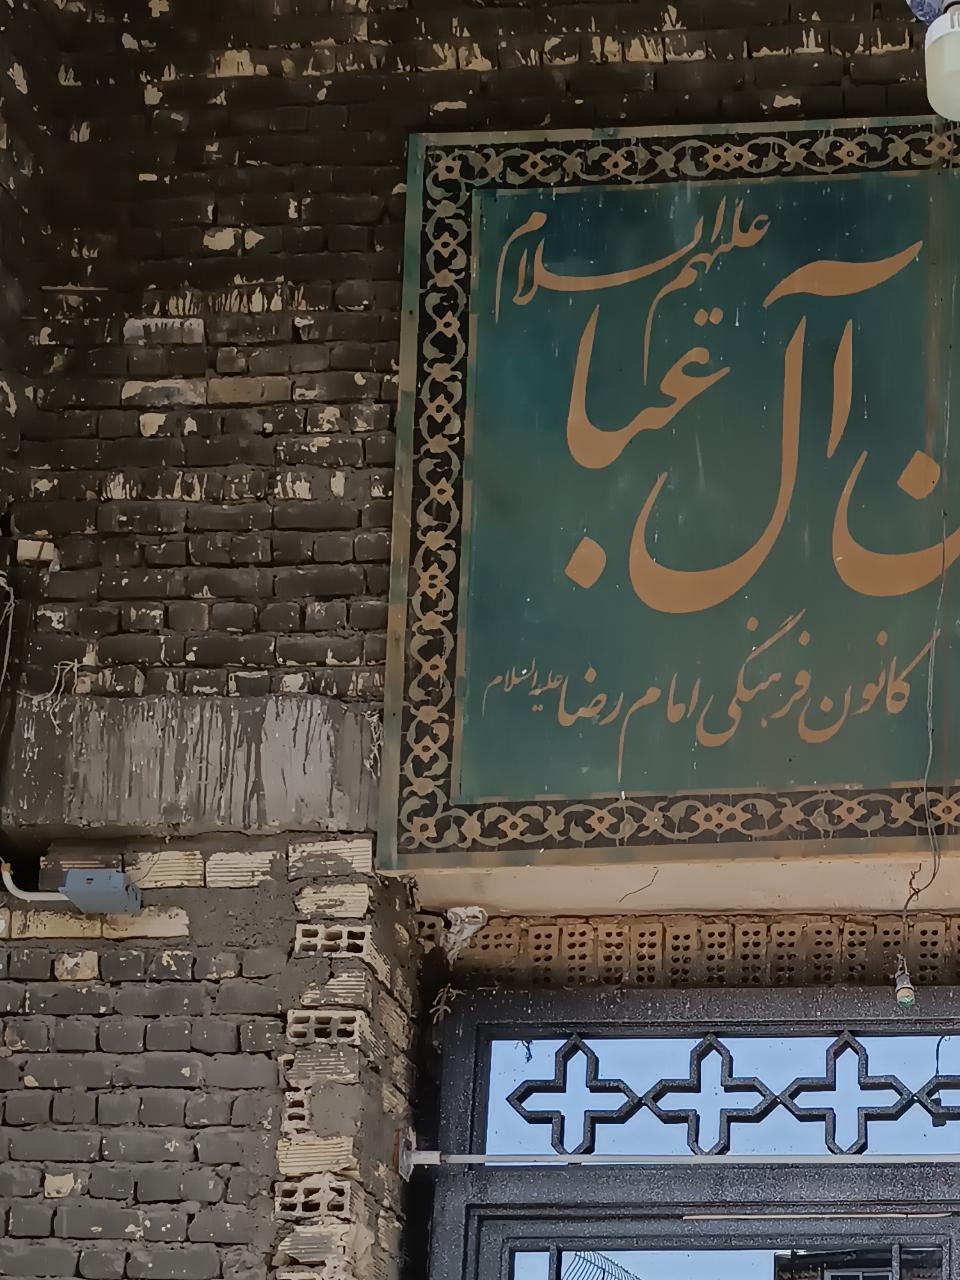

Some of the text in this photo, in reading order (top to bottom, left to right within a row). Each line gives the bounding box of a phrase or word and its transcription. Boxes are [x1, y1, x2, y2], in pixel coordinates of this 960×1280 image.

[563, 303, 731, 589] عبا
[628, 240, 924, 614] آل
[557, 664, 624, 727] رضا
[617, 672, 701, 784] امام
[696, 608, 811, 747] فرهنگی
[797, 628, 941, 743] کانون
